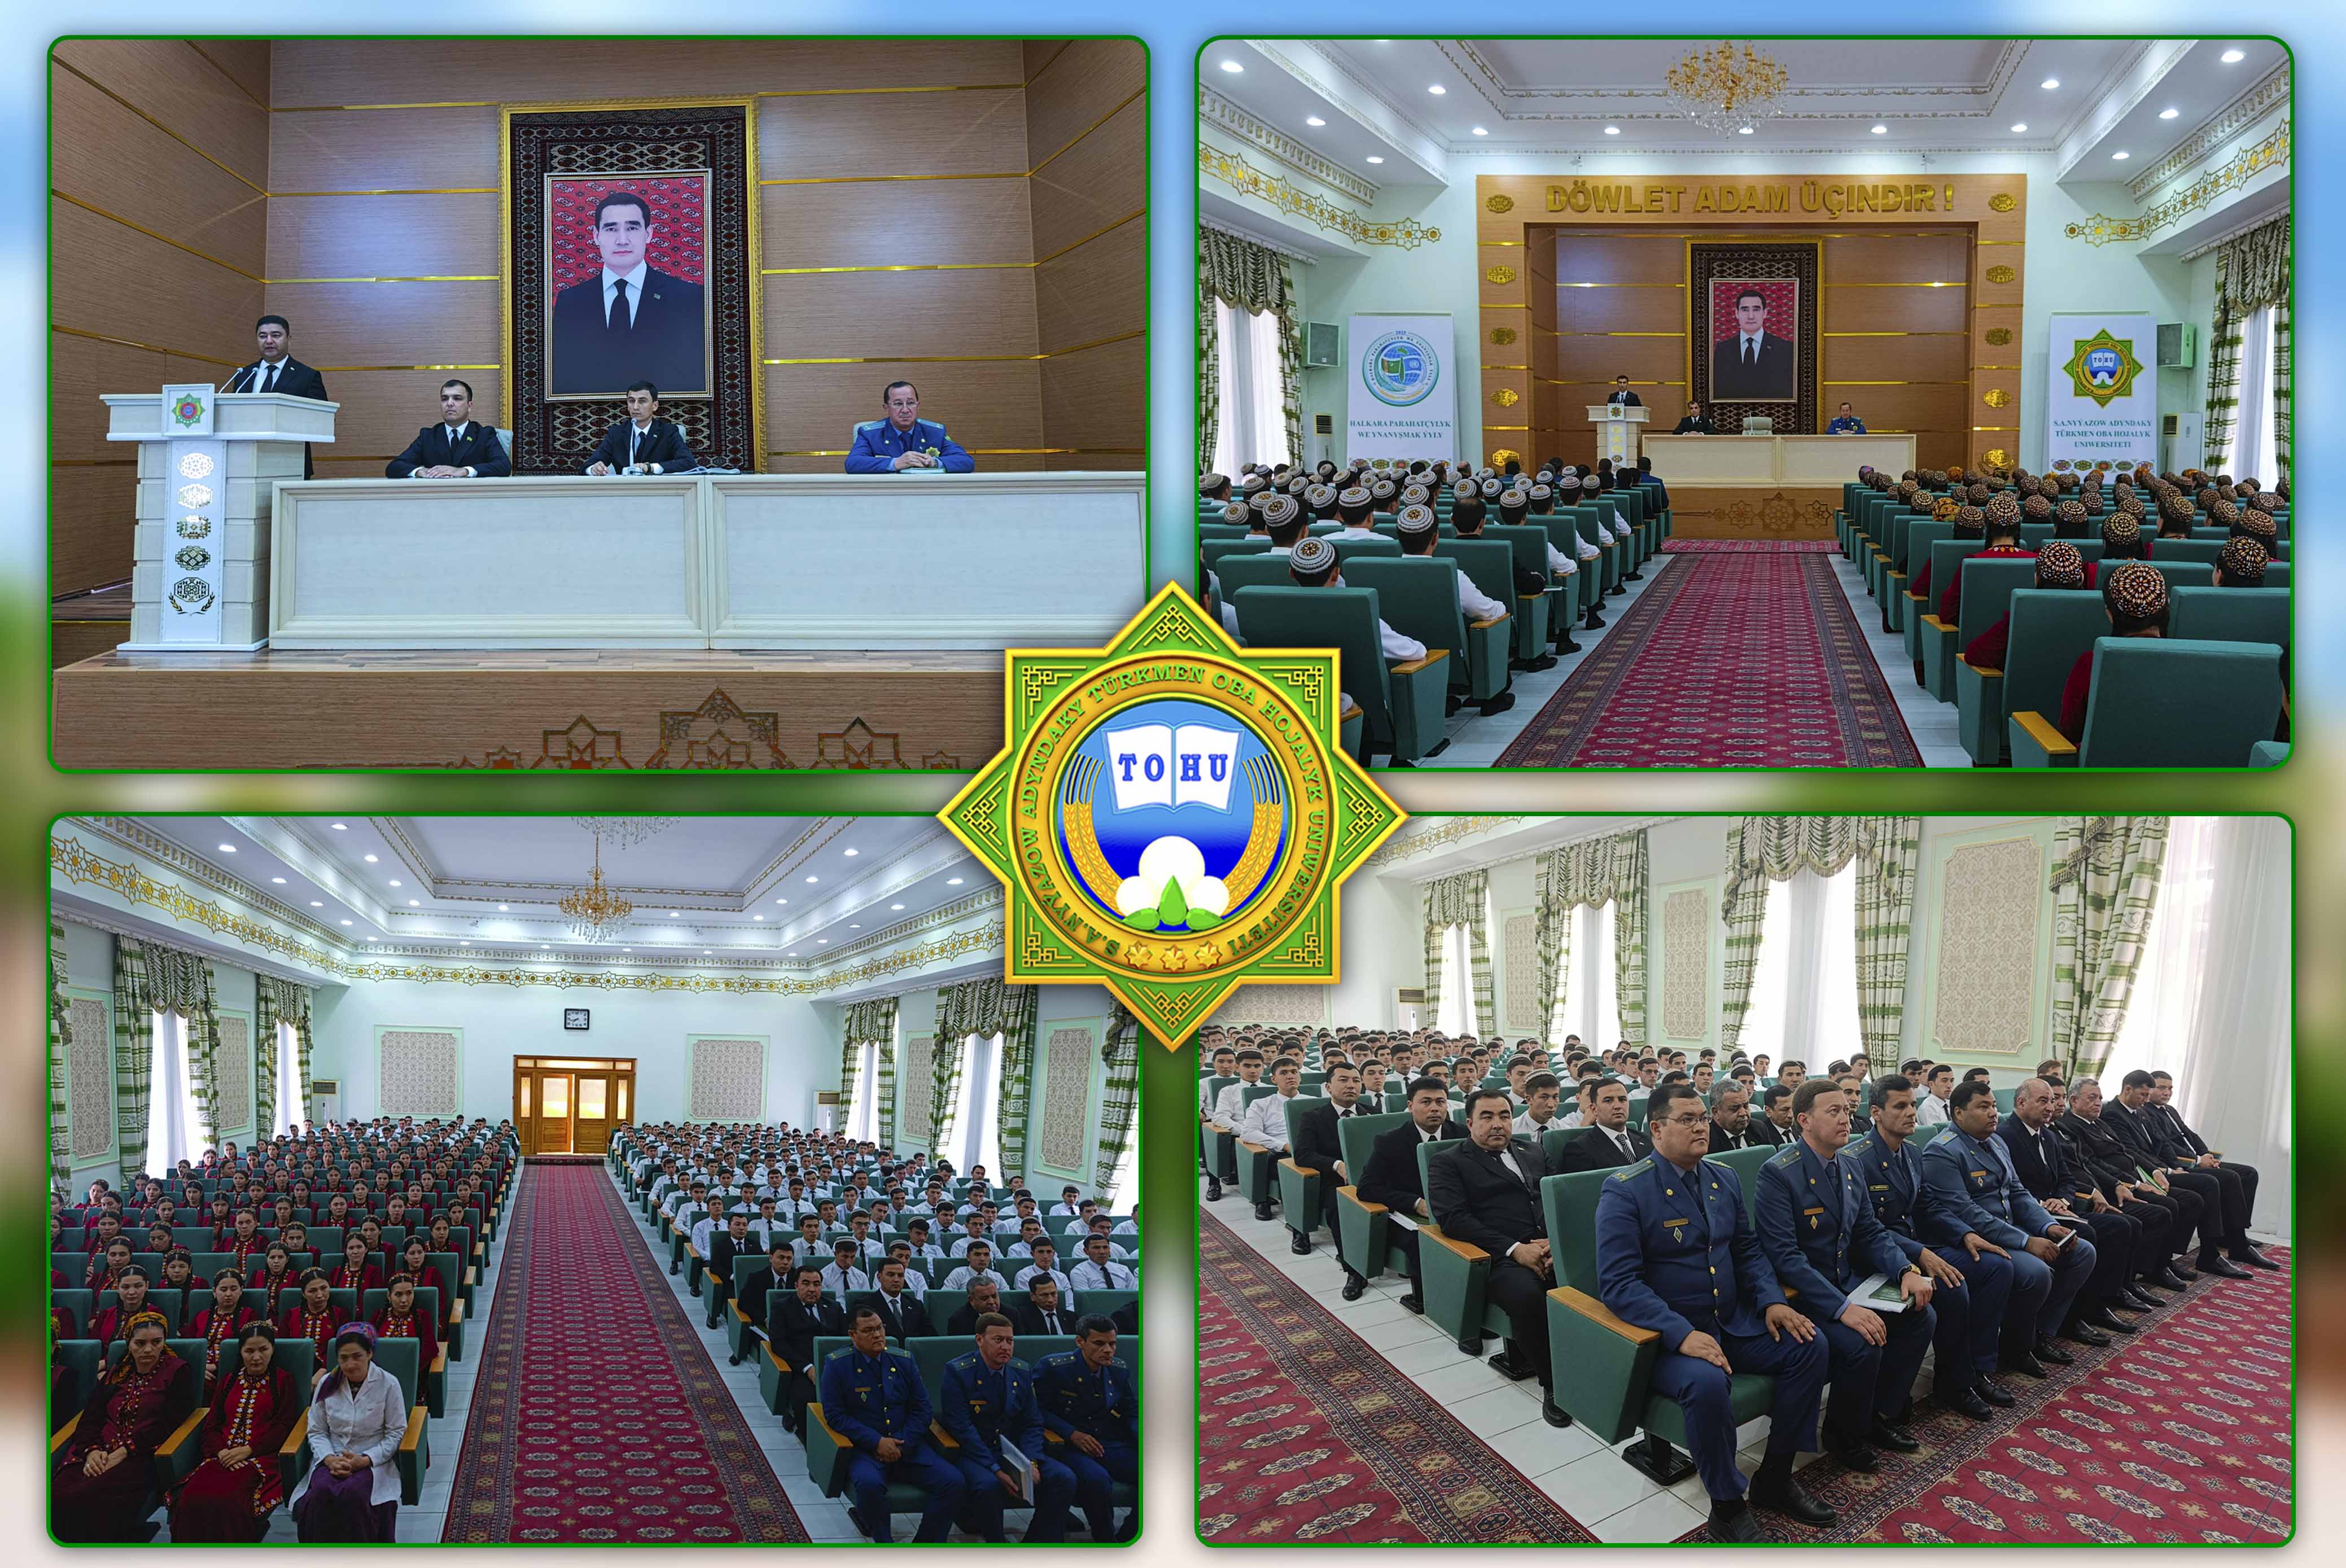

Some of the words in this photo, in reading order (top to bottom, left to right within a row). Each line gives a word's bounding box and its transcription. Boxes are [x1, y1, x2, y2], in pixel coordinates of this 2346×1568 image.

[1546, 180, 1687, 213] DÖWLET
[1694, 185, 1790, 213] ADAM
[1800, 180, 1935, 220] ÜÇINDIR
[1389, 420, 1451, 428] PARAHATÇYLYK
